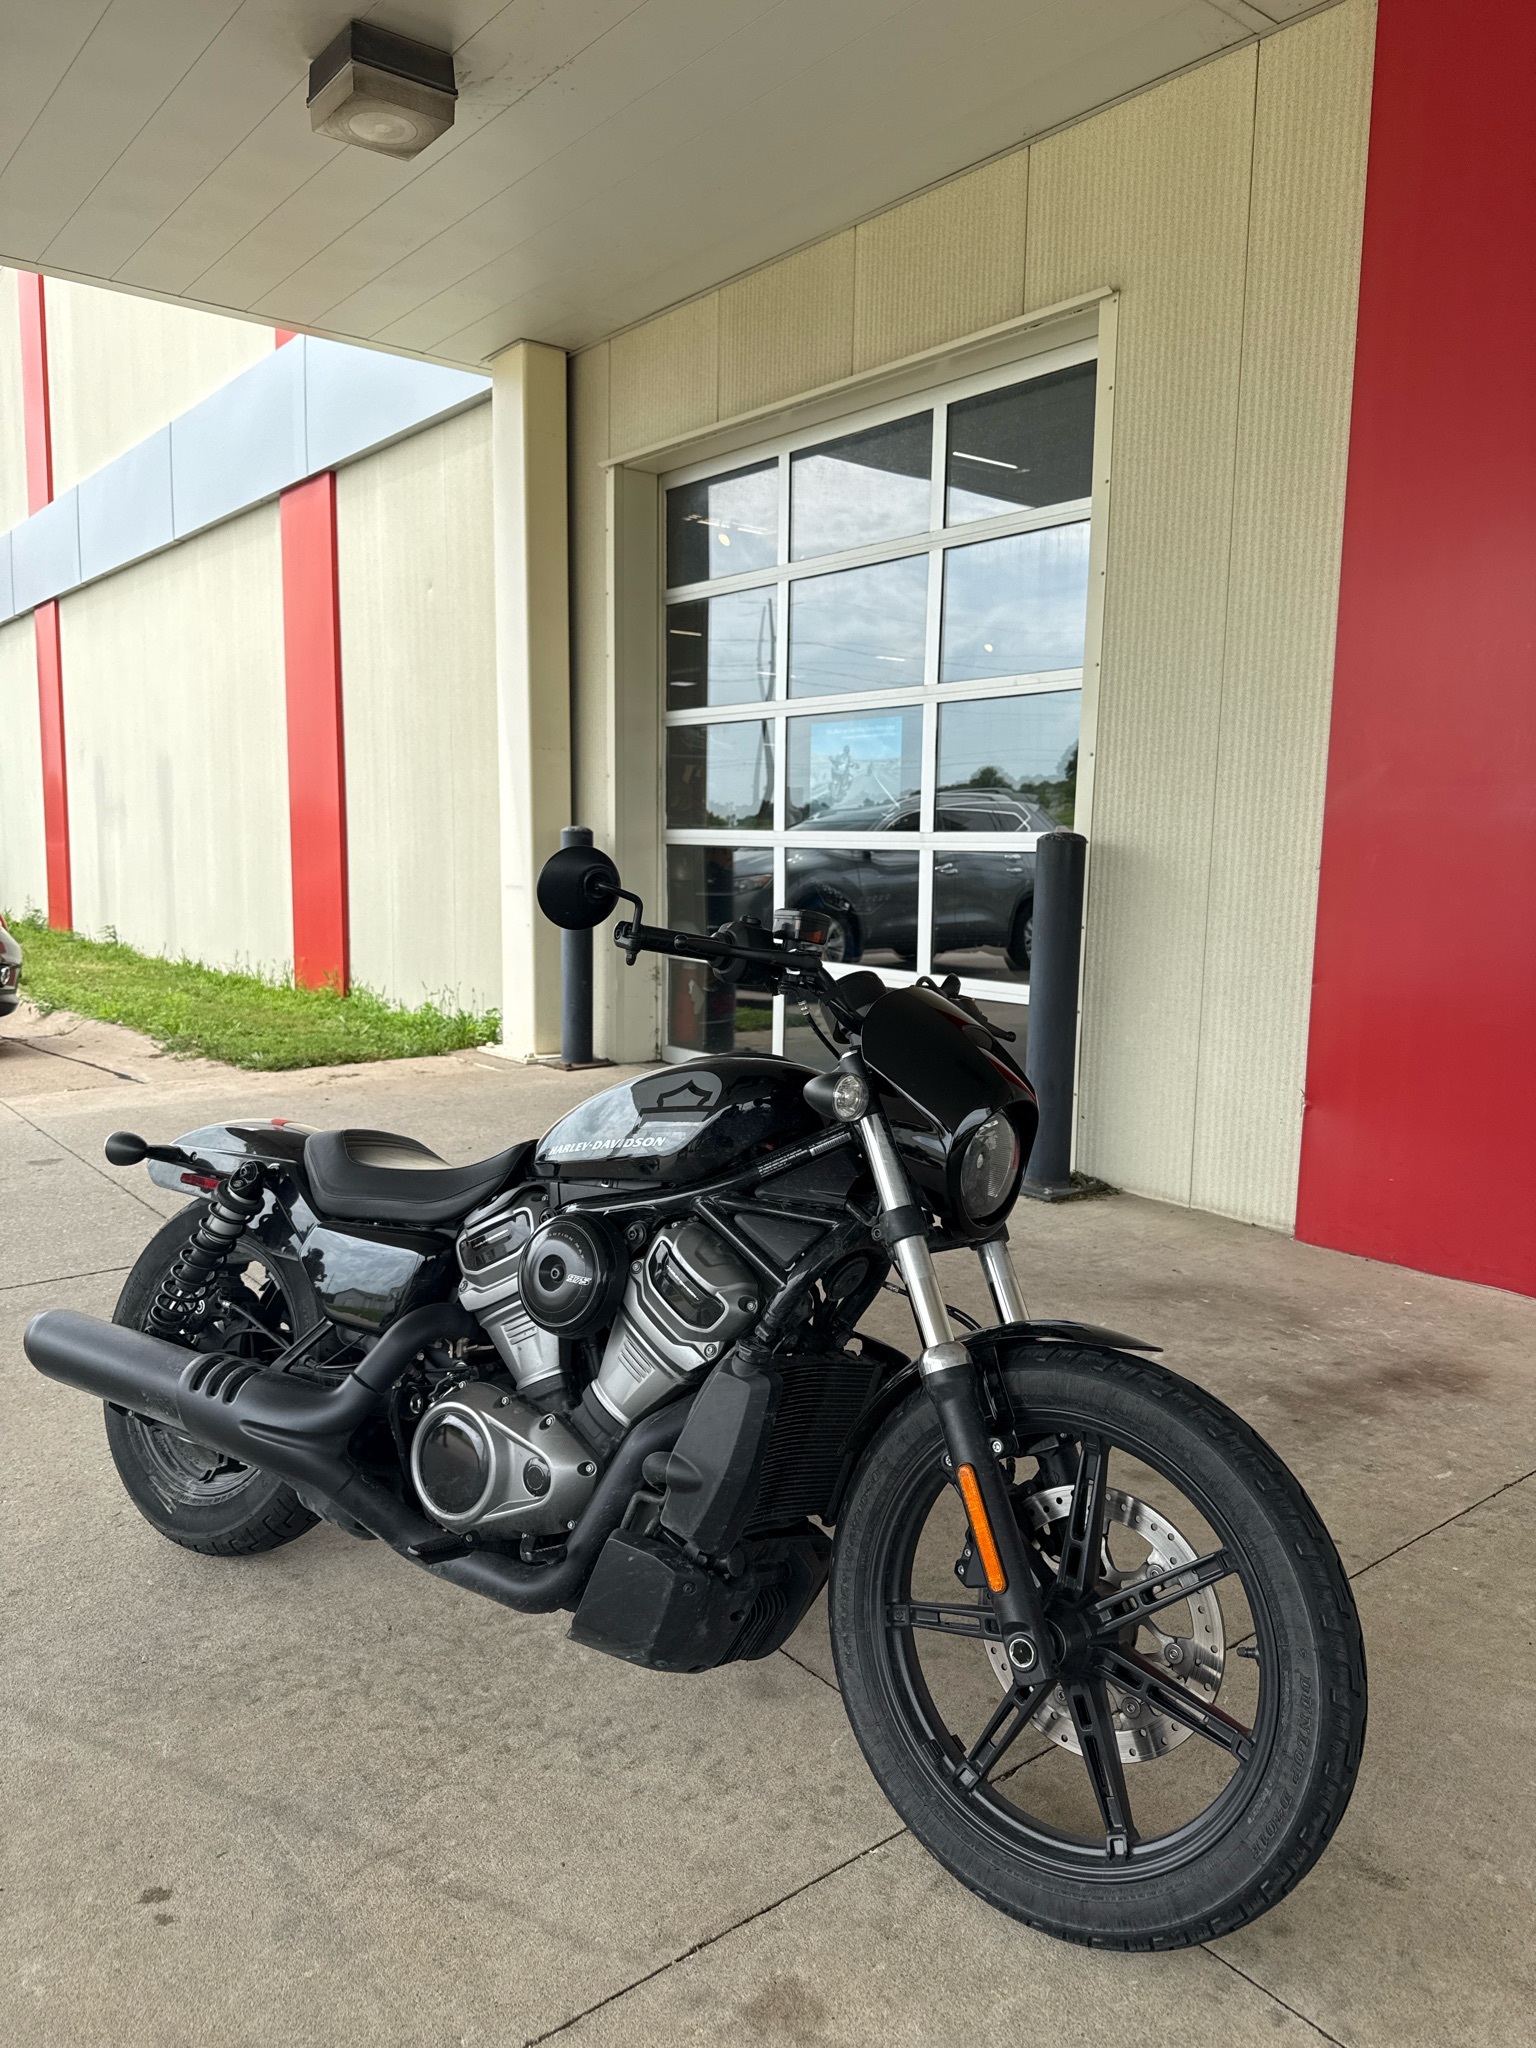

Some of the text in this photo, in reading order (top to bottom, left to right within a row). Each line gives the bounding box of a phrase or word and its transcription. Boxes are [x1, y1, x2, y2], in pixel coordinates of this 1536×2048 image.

[548, 1136, 667, 1156] HARLEY-DAVIDSON
[566, 1273, 592, 1285] 975
[1292, 1672, 1313, 1785] DUNLOP
